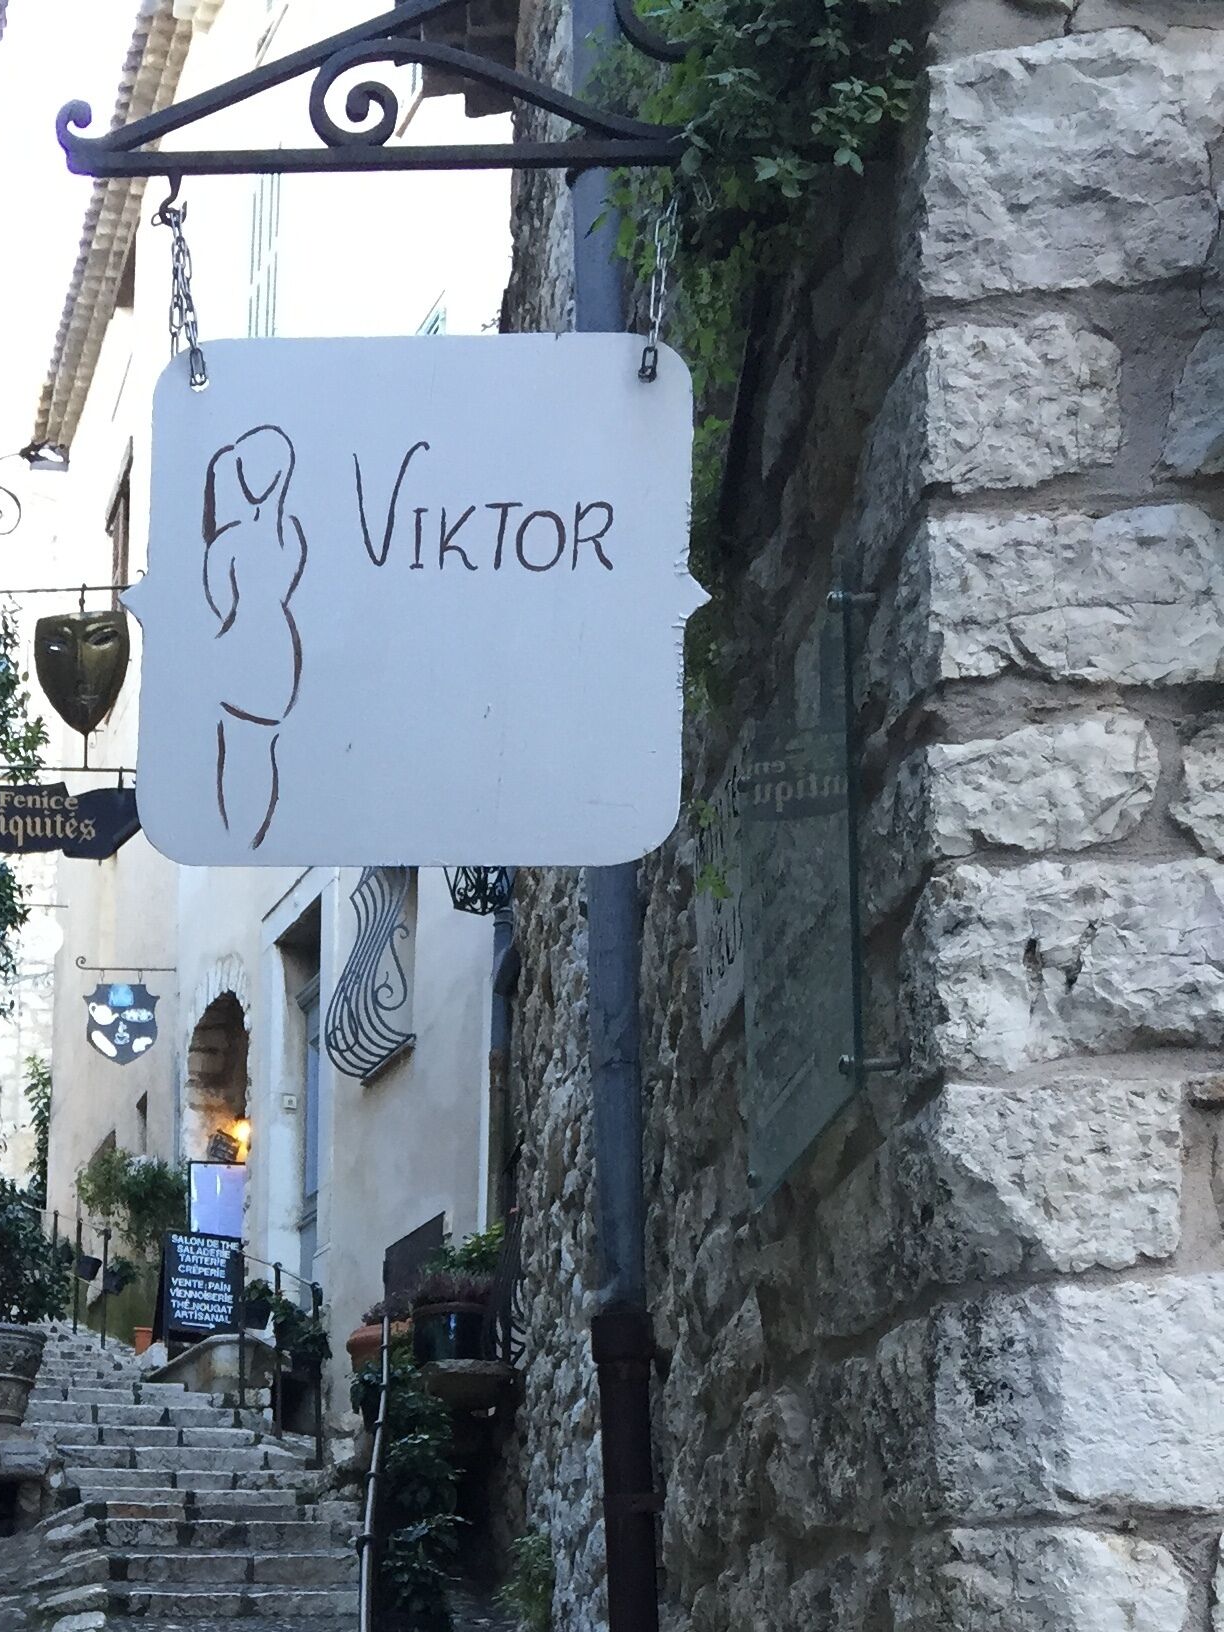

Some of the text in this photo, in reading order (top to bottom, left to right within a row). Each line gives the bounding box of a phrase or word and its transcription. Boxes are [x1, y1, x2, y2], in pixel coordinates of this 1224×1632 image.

[172, 1235, 204, 1246] SALON
[207, 1239, 218, 1247] DE
[177, 1245, 230, 1258] SALADERIE
[180, 1255, 226, 1266] TARTERIE
[208, 1281, 231, 1292] PAIN
[170, 1288, 233, 1303] VIENNOISERIE
[175, 1310, 231, 1323] ARTISANAL
